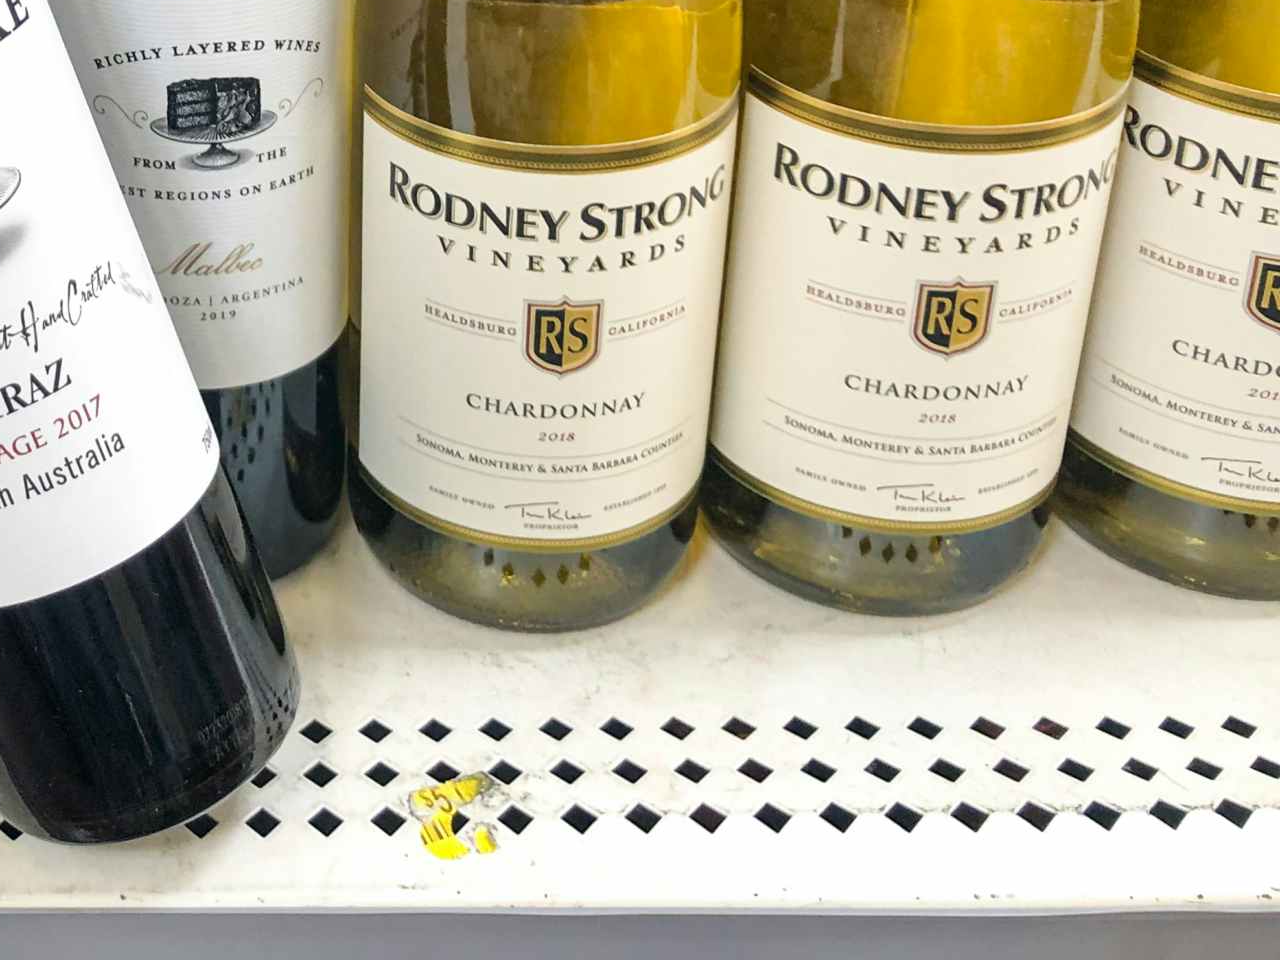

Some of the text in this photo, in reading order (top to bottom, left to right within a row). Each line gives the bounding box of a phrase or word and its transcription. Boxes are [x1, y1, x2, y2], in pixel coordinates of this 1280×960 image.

[93, 38, 322, 71] RICHLY LAYERED WINES
[133, 146, 289, 170] FROM THE
[1123, 103, 1280, 193] RODNE
[154, 189, 233, 201] REGIONS
[240, 184, 263, 198] ON
[269, 165, 316, 191] EARTH
[773, 140, 971, 223] RODNEY
[1163, 177, 1280, 226] VINE
[388, 161, 726, 243] RODNEY STRONG
[437, 233, 687, 274] VINEYARDS
[826, 216, 1080, 255] VINEYARDS
[158, 241, 264, 277] Malbec
[1138, 245, 1240, 287] HEALDSBURG
[221, 275, 305, 305] ARGENTINA
[200, 309, 237, 322] 2019
[424, 303, 687, 355] HEALDSBURG RS CALIFORNIA
[805, 284, 906, 318] HEALDSBURG
[927, 297, 981, 337] RS
[1172, 339, 1280, 378] CHARD
[465, 391, 646, 420] CHARDONNAY
[844, 373, 1030, 402] CHARDONNAY
[1110, 373, 1280, 434] SONOMA, MONTEREY & SAN
[1247, 387, 1280, 401] 201
[53, 393, 104, 440] 2017
[537, 431, 577, 442] 2018
[784, 414, 838, 442] SONOMA,
[841, 434, 911, 455] MONTEREY
[914, 445, 925, 455] &
[928, 445, 967, 456] SANTA
[918, 413, 958, 425] 2018
[21, 430, 127, 500] Australia
[415, 432, 465, 460] SONOMA,
[468, 452, 535, 473] MONTEREY
[536, 463, 548, 473] &
[551, 464, 589, 473] SANTA
[591, 453, 639, 472] BARBARA
